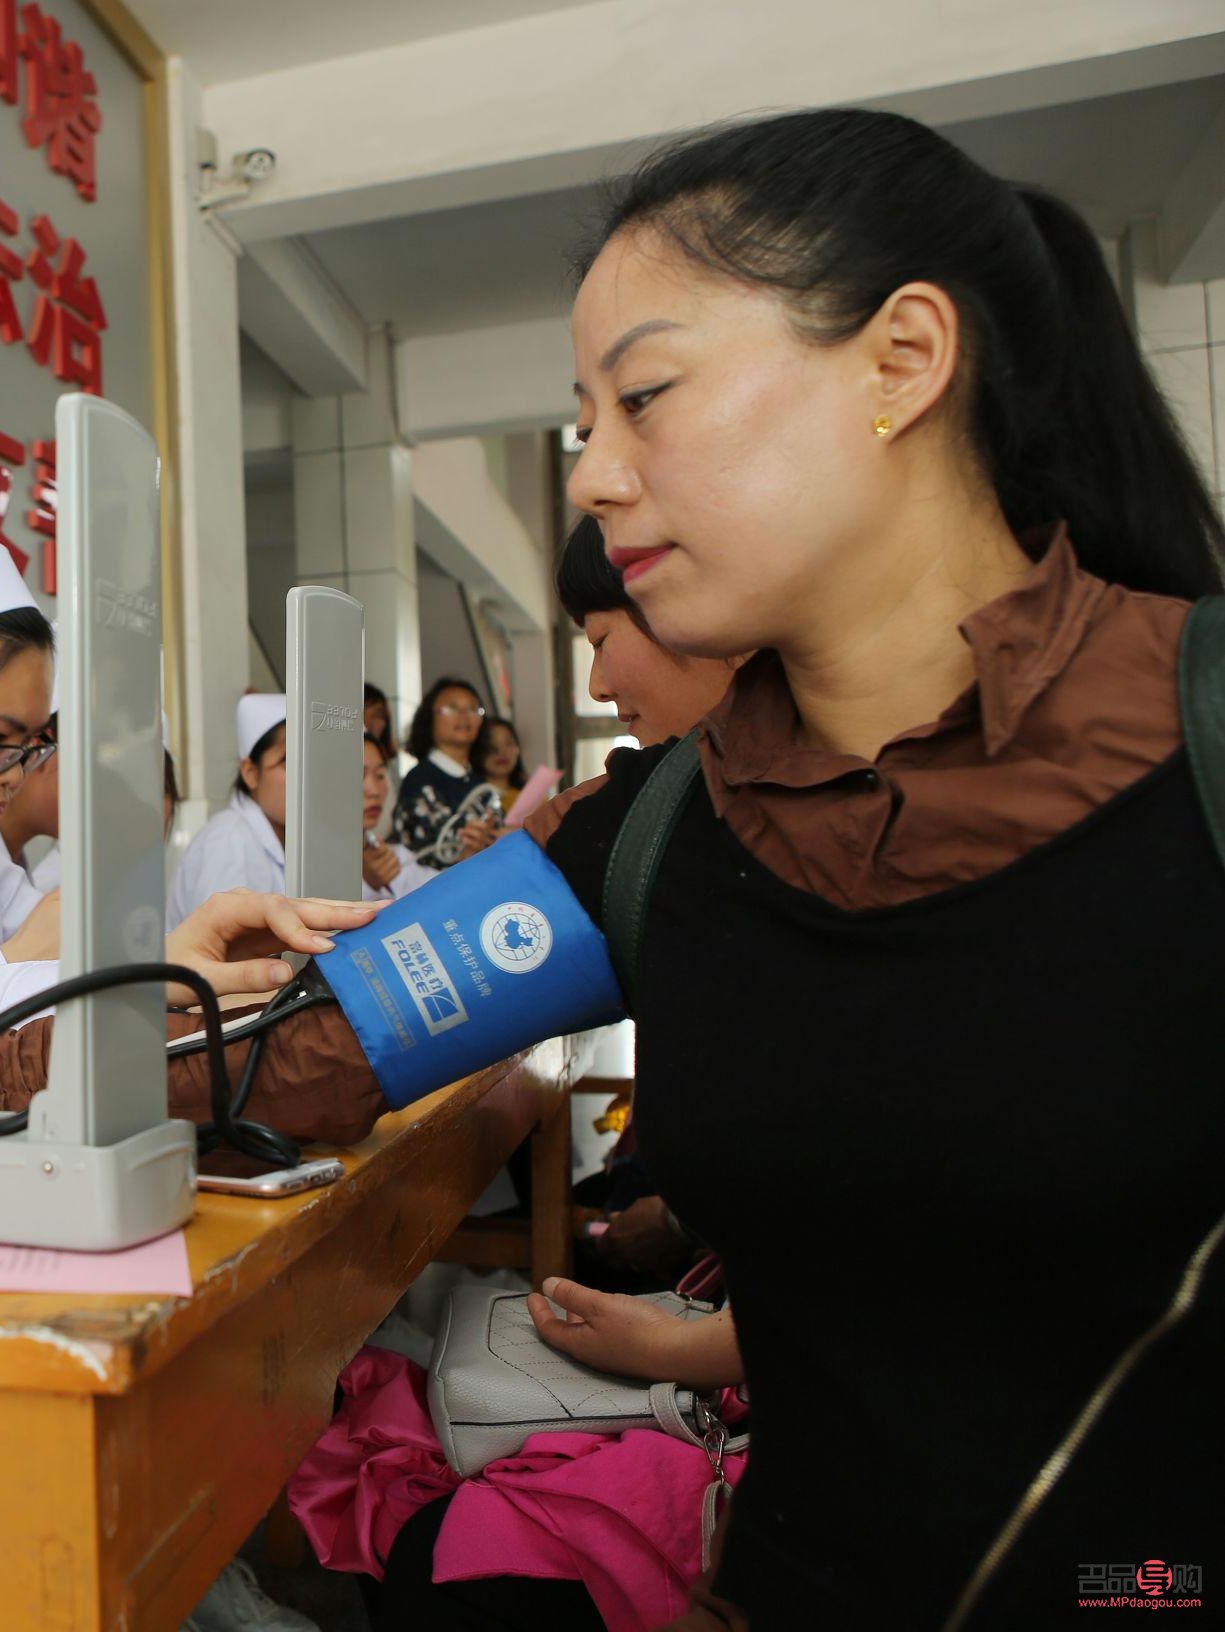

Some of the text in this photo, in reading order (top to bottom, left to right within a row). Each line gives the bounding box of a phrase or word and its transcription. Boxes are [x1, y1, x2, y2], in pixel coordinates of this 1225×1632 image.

[390, 939, 430, 995] FOLEE
[442, 918, 493, 998] 重点保护品牌
